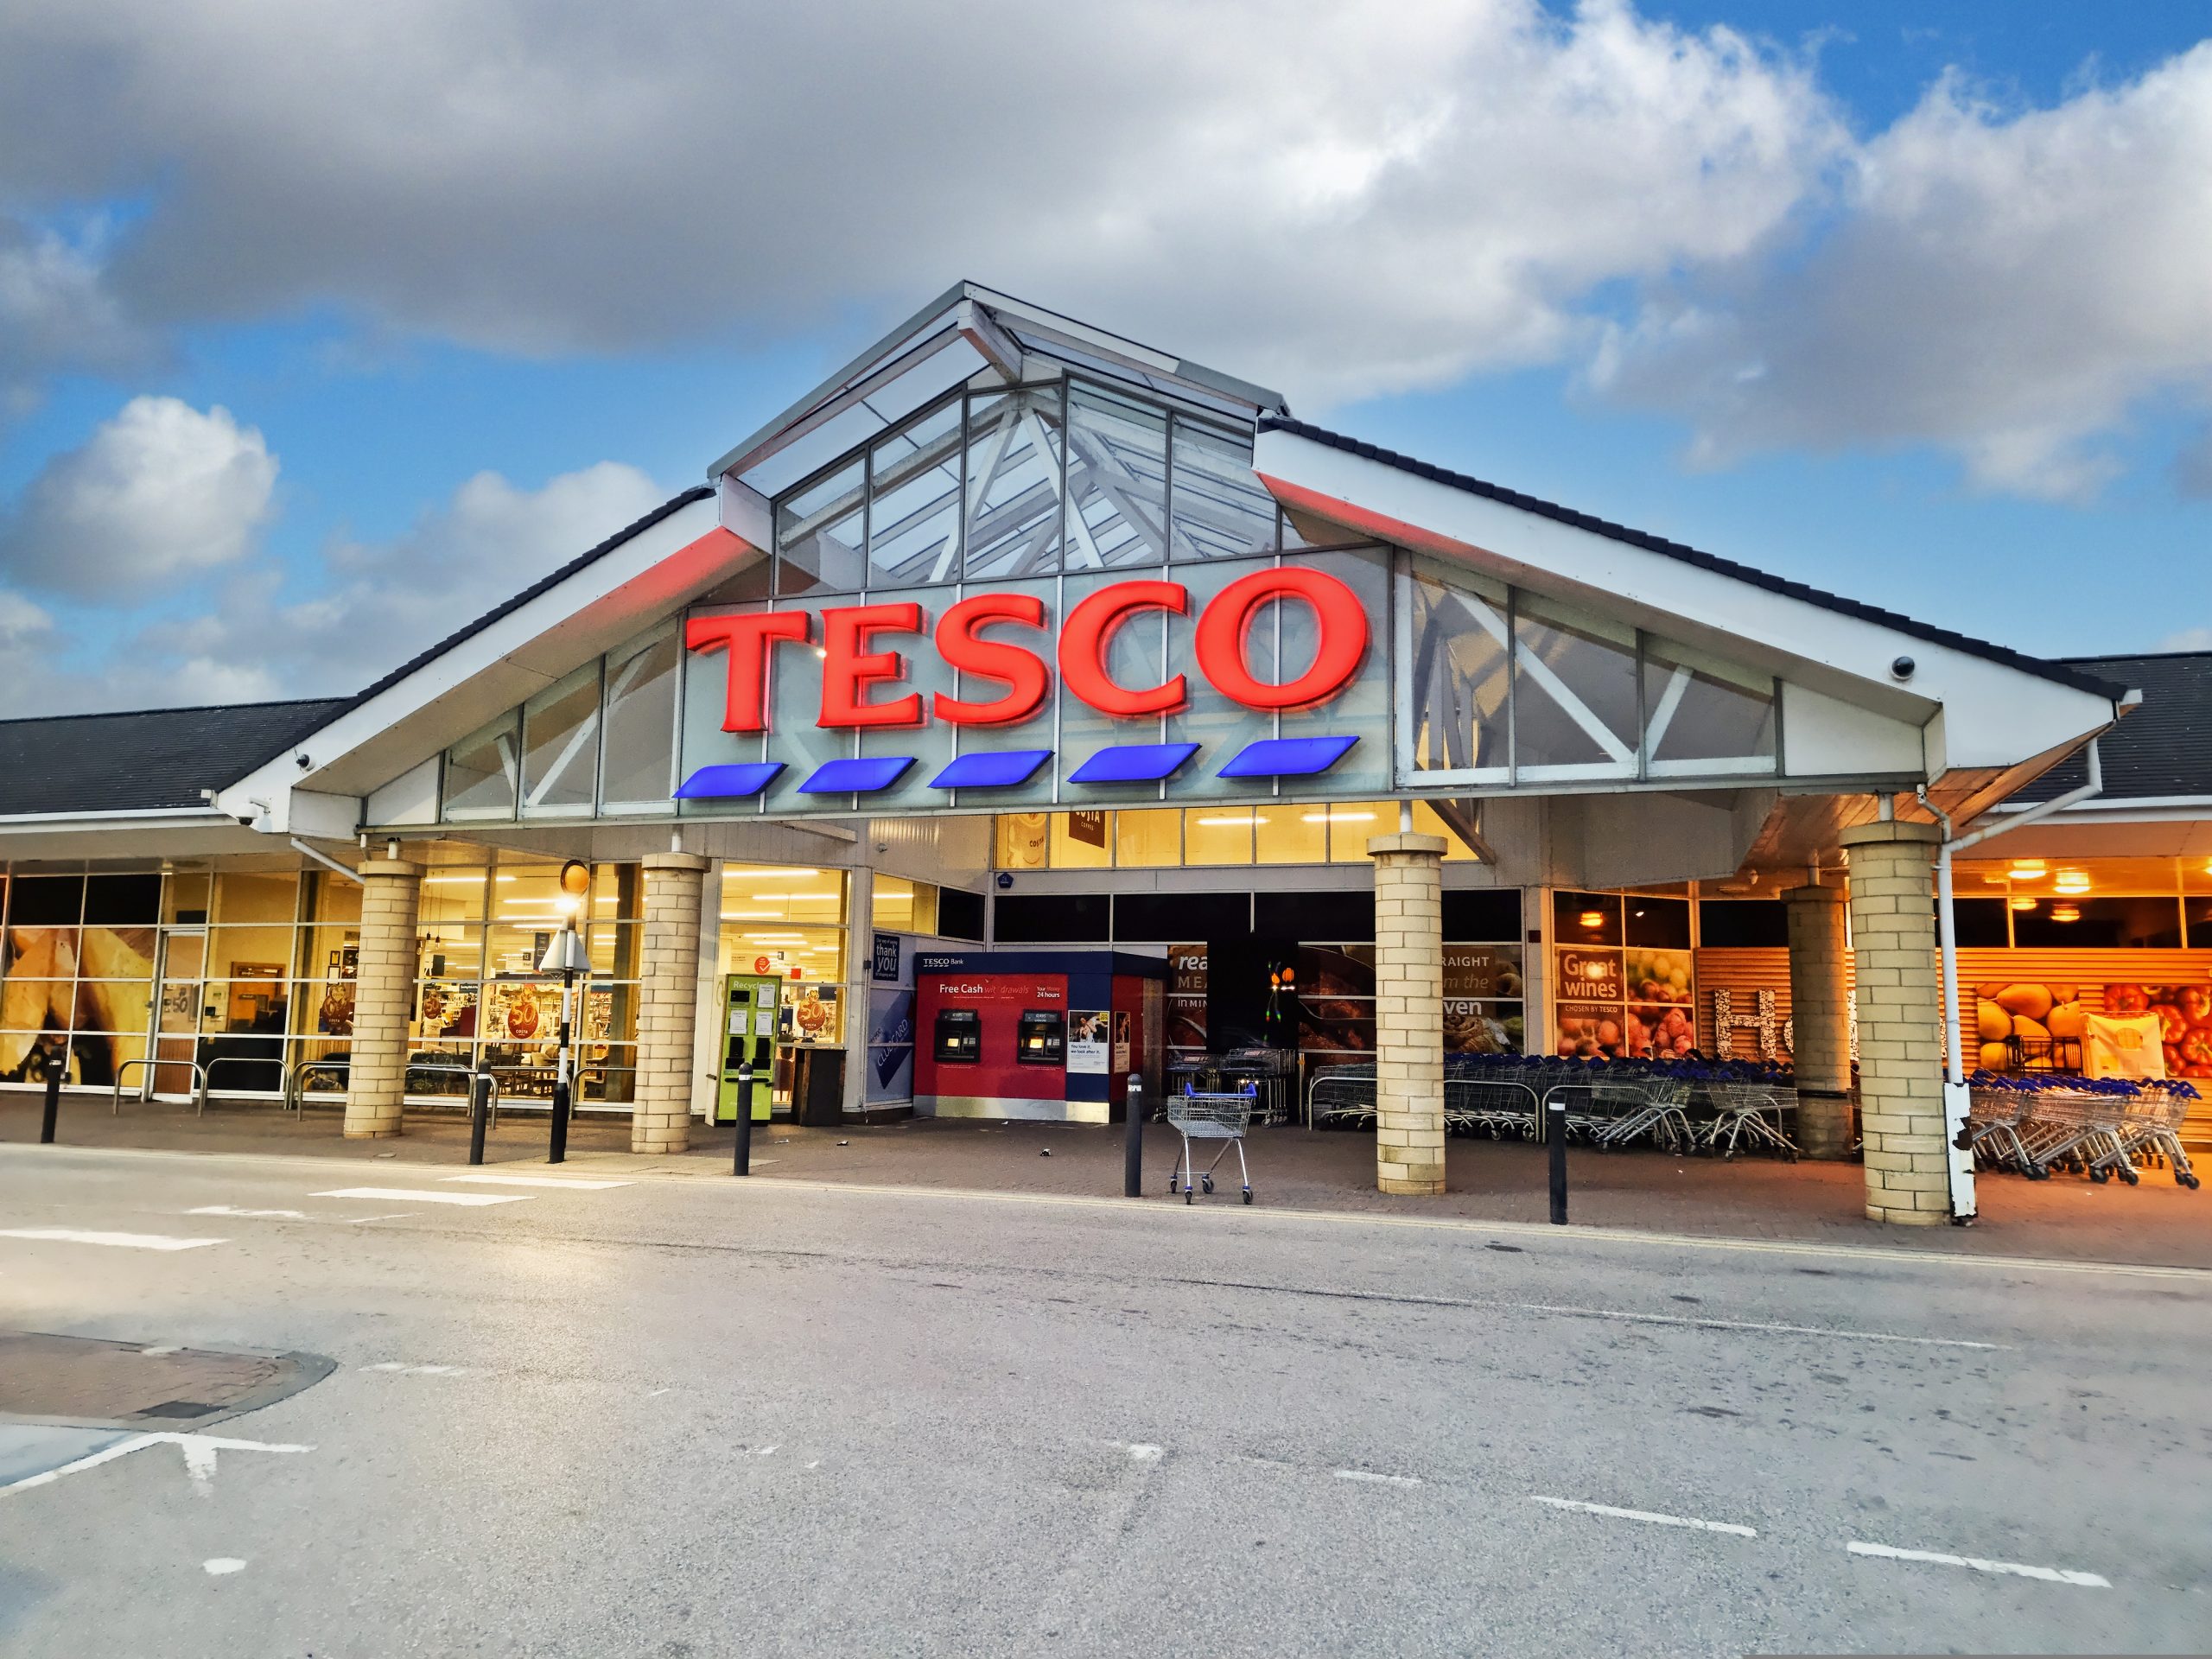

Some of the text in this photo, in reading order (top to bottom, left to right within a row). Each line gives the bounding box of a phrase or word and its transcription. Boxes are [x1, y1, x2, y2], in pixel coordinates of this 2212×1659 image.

[686, 567, 1370, 734] TESCO
[876, 944, 897, 957] thank
[877, 957, 897, 972] you
[734, 981, 760, 991] Recycl
[1464, 973, 1489, 988] the
[1564, 977, 1618, 998] wines
[939, 984, 959, 994] Free
[960, 983, 983, 994] Cash
